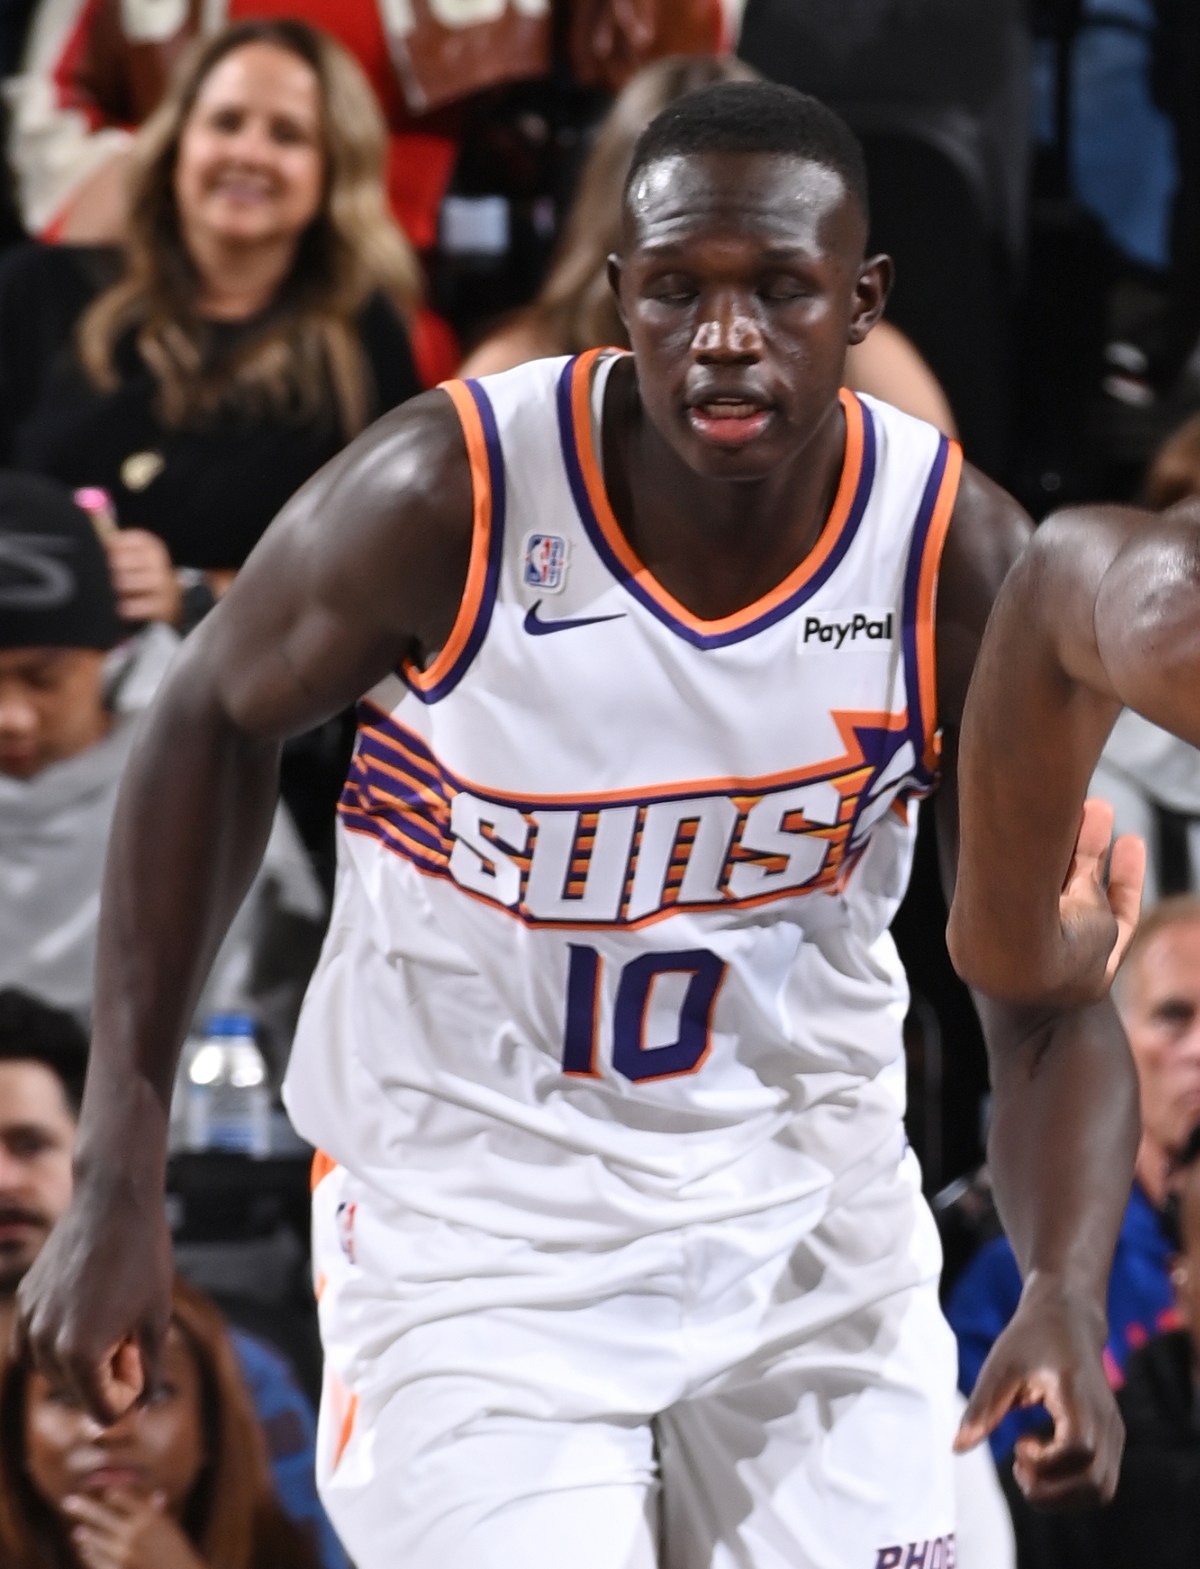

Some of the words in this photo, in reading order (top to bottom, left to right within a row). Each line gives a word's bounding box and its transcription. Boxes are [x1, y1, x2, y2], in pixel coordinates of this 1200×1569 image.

[803, 612, 893, 650] PayPal
[449, 782, 842, 921] SUNS
[562, 941, 731, 1085] 10
